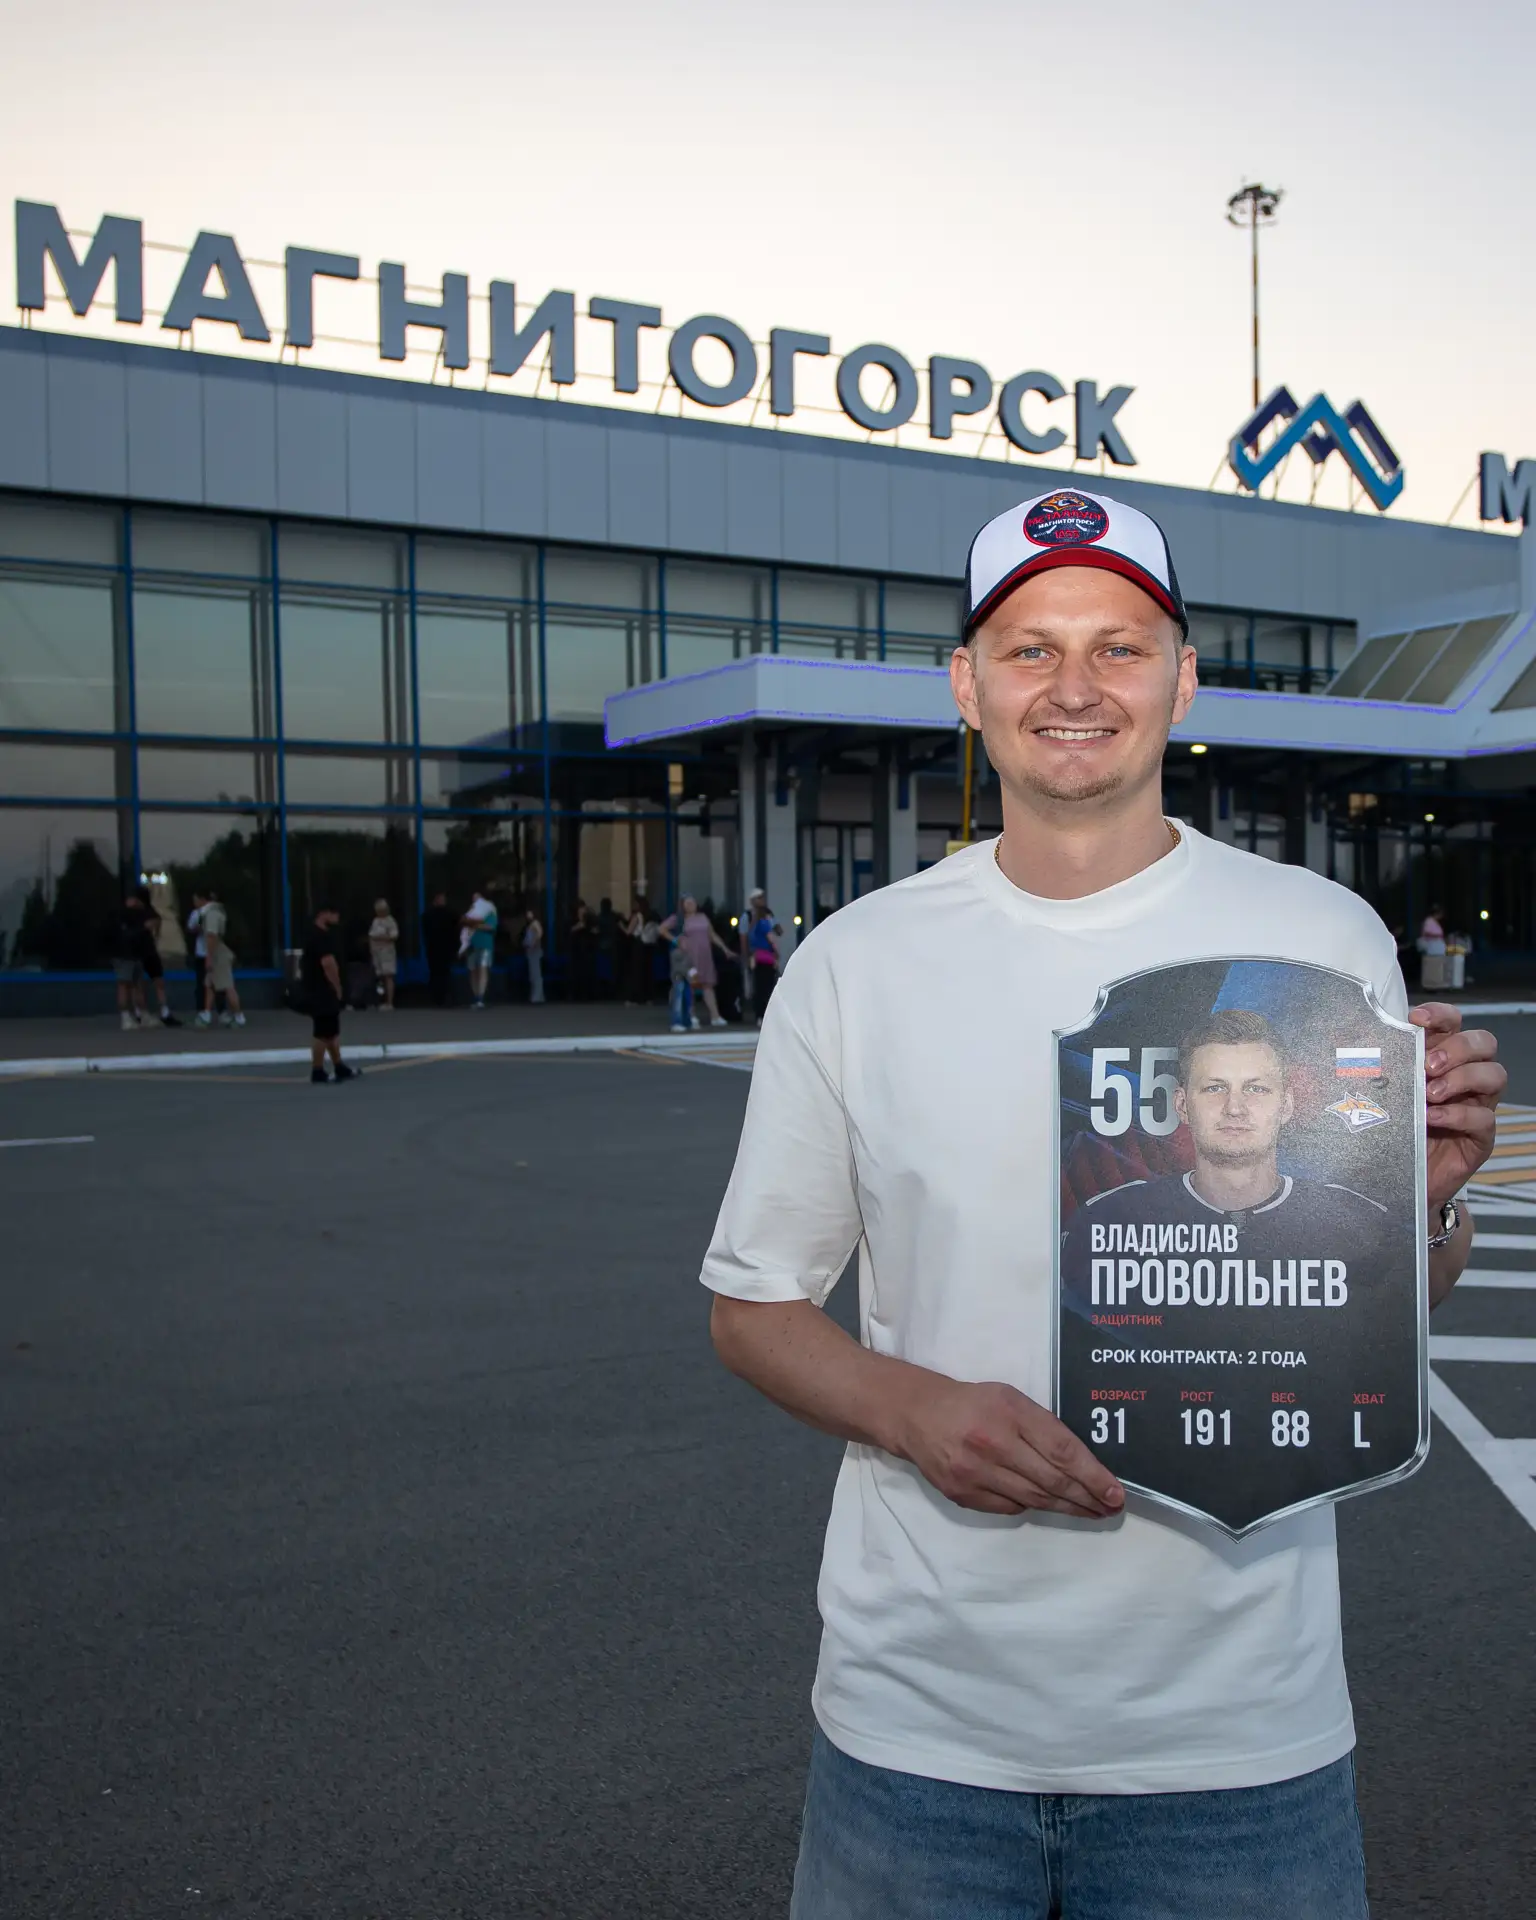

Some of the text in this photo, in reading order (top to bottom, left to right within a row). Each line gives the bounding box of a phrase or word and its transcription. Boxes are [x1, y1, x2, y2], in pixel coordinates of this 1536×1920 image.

[15, 199, 1137, 466] МАГНИТОГОРСК
[1090, 1047, 1180, 1137] 55
[1091, 1224, 1239, 1256] ВЛАДИСЛАВ
[1091, 1259, 1348, 1307] ПРОВОЛЬНЕВ
[1091, 1314, 1162, 1326] ЗАЩИТНИК
[1091, 1349, 1307, 1367] СРОК КОНТРАКТА: 2 ГОДА
[1091, 1390, 1147, 1401] ВОЗРАСТ
[1181, 1392, 1214, 1402] РОСТ
[1271, 1392, 1296, 1403] ВЕС
[1353, 1393, 1386, 1404] ХВАТ
[1091, 1407, 1125, 1444] 31
[1180, 1408, 1231, 1446] 191
[1271, 1410, 1310, 1447] 88
[1354, 1411, 1371, 1448] L
